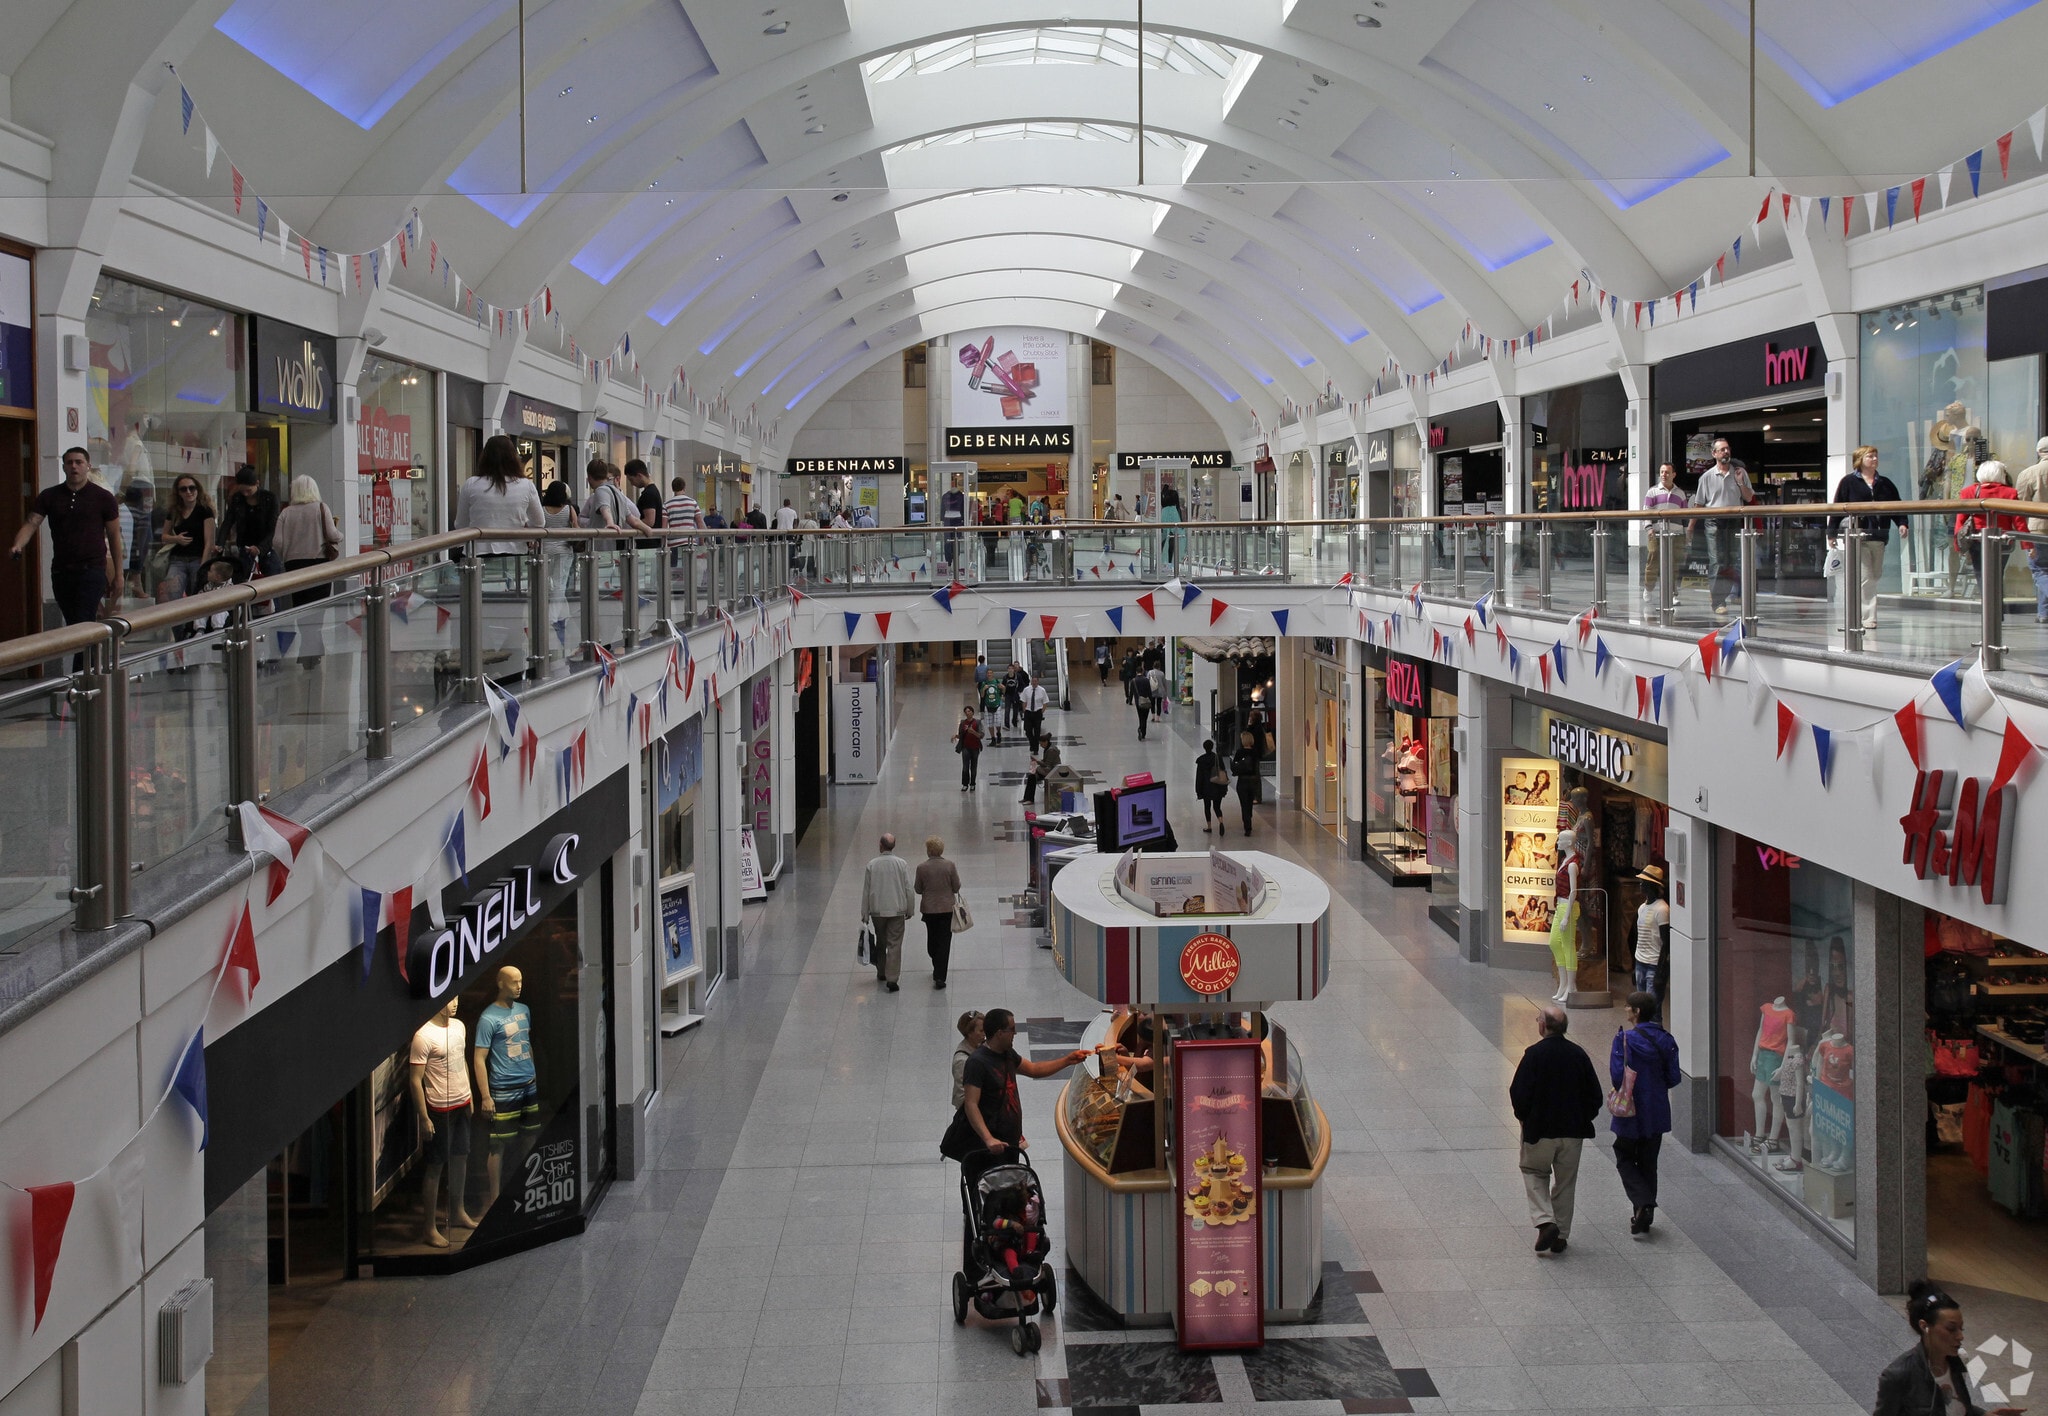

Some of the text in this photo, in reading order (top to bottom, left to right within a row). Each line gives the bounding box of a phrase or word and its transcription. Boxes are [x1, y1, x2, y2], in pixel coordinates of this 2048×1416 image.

[276, 340, 323, 410] wallis
[1765, 342, 1809, 387] hmv
[522, 405, 557, 434] vision express
[1429, 423, 1445, 448] hmv
[357, 424, 370, 456] ALE
[949, 433, 1071, 447] DEBENHAMS
[1369, 440, 1388, 464] Clarks
[796, 459, 896, 472] DEBENHAMS
[1563, 451, 1607, 509] hmv
[359, 494, 372, 525] ALE
[851, 687, 864, 759] mothercare
[1549, 718, 1632, 783] REPUBLIC
[754, 740, 771, 831] GAME
[1514, 811, 1547, 825] Miso
[1899, 769, 2004, 906] H&M
[1506, 875, 1555, 887] CRAFTED
[429, 867, 542, 999] O'NEILL
[1185, 937, 1231, 957] FRESHLY BAKED
[1183, 950, 1238, 978] Millie's
[1190, 971, 1236, 991] COOKIES
[1216, 1095, 1241, 1109] CUPCAKES
[1815, 1093, 1852, 1131] SUMMER
[1815, 1112, 1847, 1146] OFFERS
[525, 1152, 544, 1188] 2
[524, 1178, 575, 1214] 25.00
